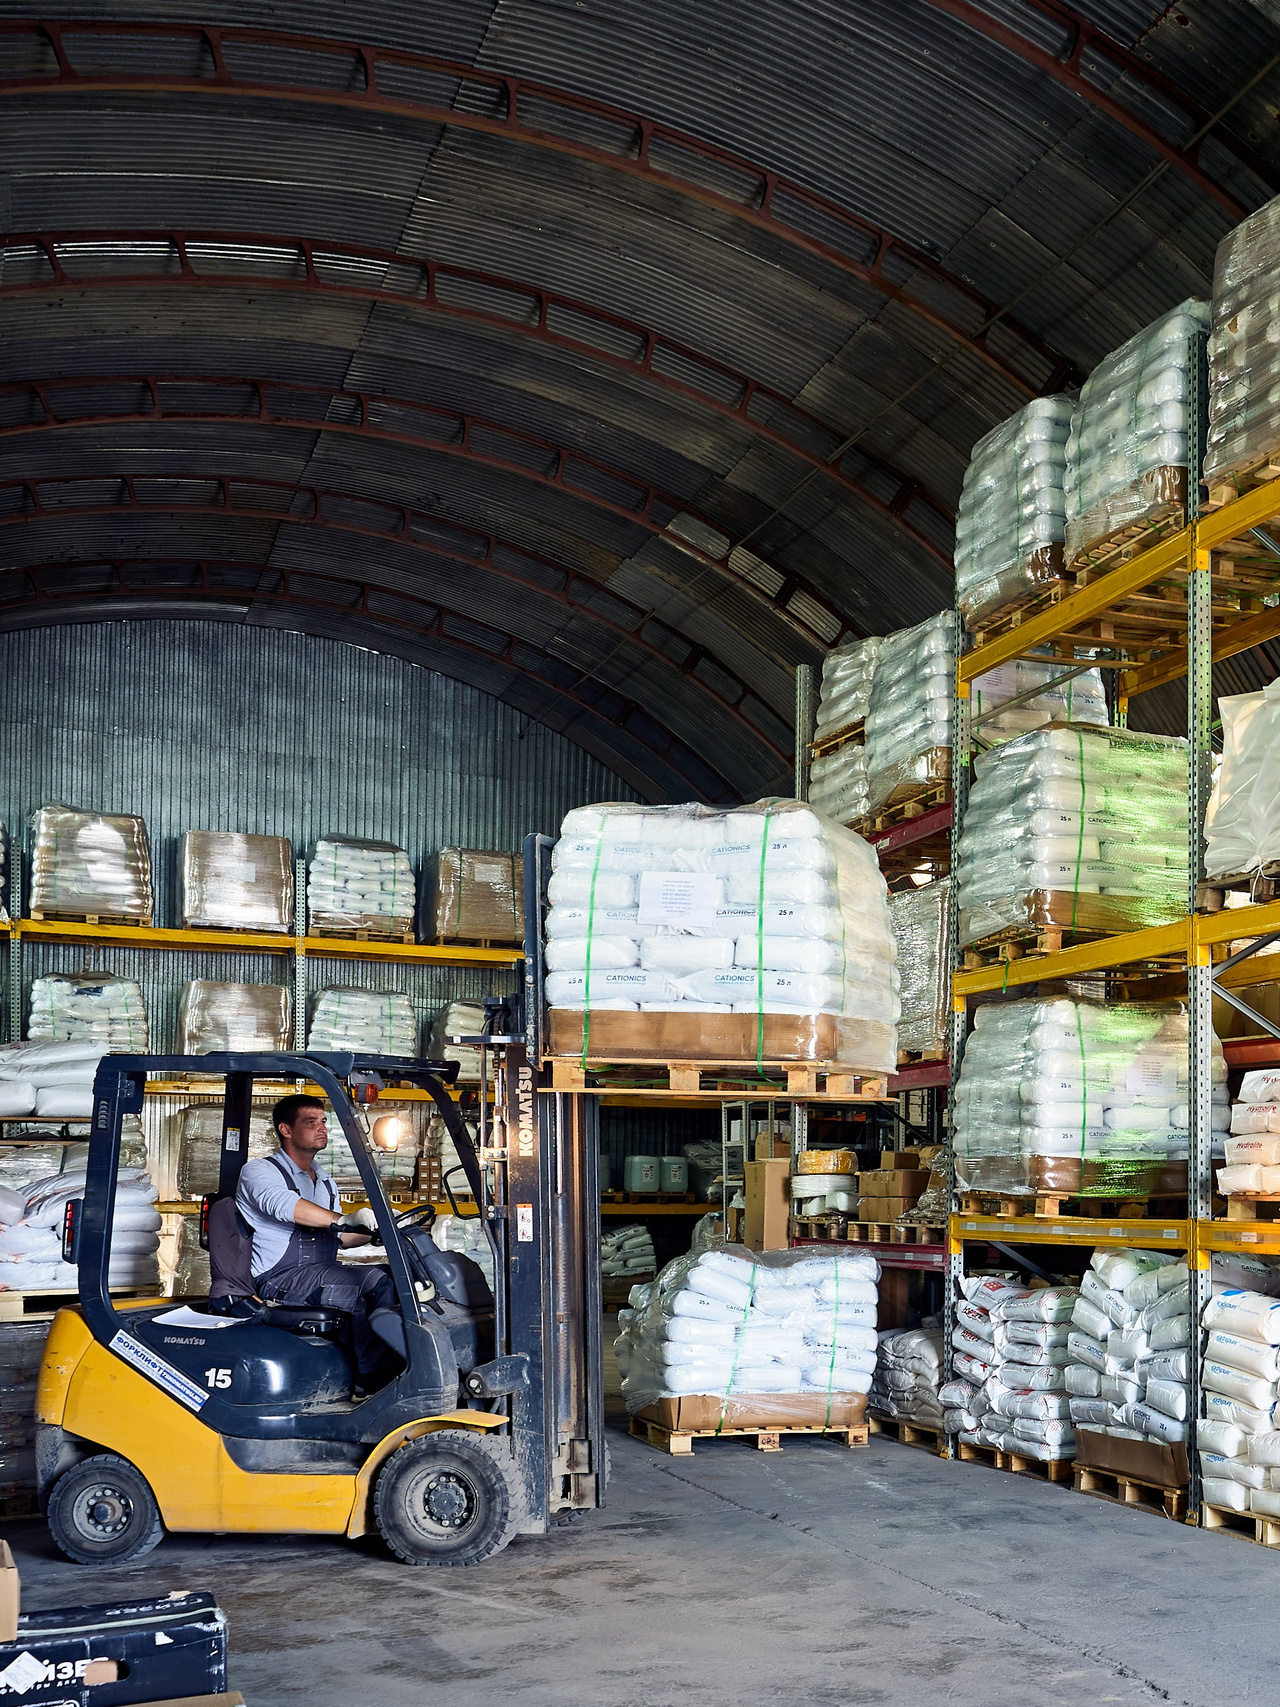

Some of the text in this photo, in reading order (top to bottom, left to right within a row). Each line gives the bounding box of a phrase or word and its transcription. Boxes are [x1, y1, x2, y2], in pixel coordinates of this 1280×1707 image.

[606, 974, 646, 982] CATIONICS
[714, 974, 754, 982] CATIONICS
[518, 1066, 533, 1156] KOMATSU
[164, 1336, 206, 1346] KOMATSU
[116, 1336, 162, 1373] ФОРКЛИФТ
[204, 1368, 232, 1388] 15
